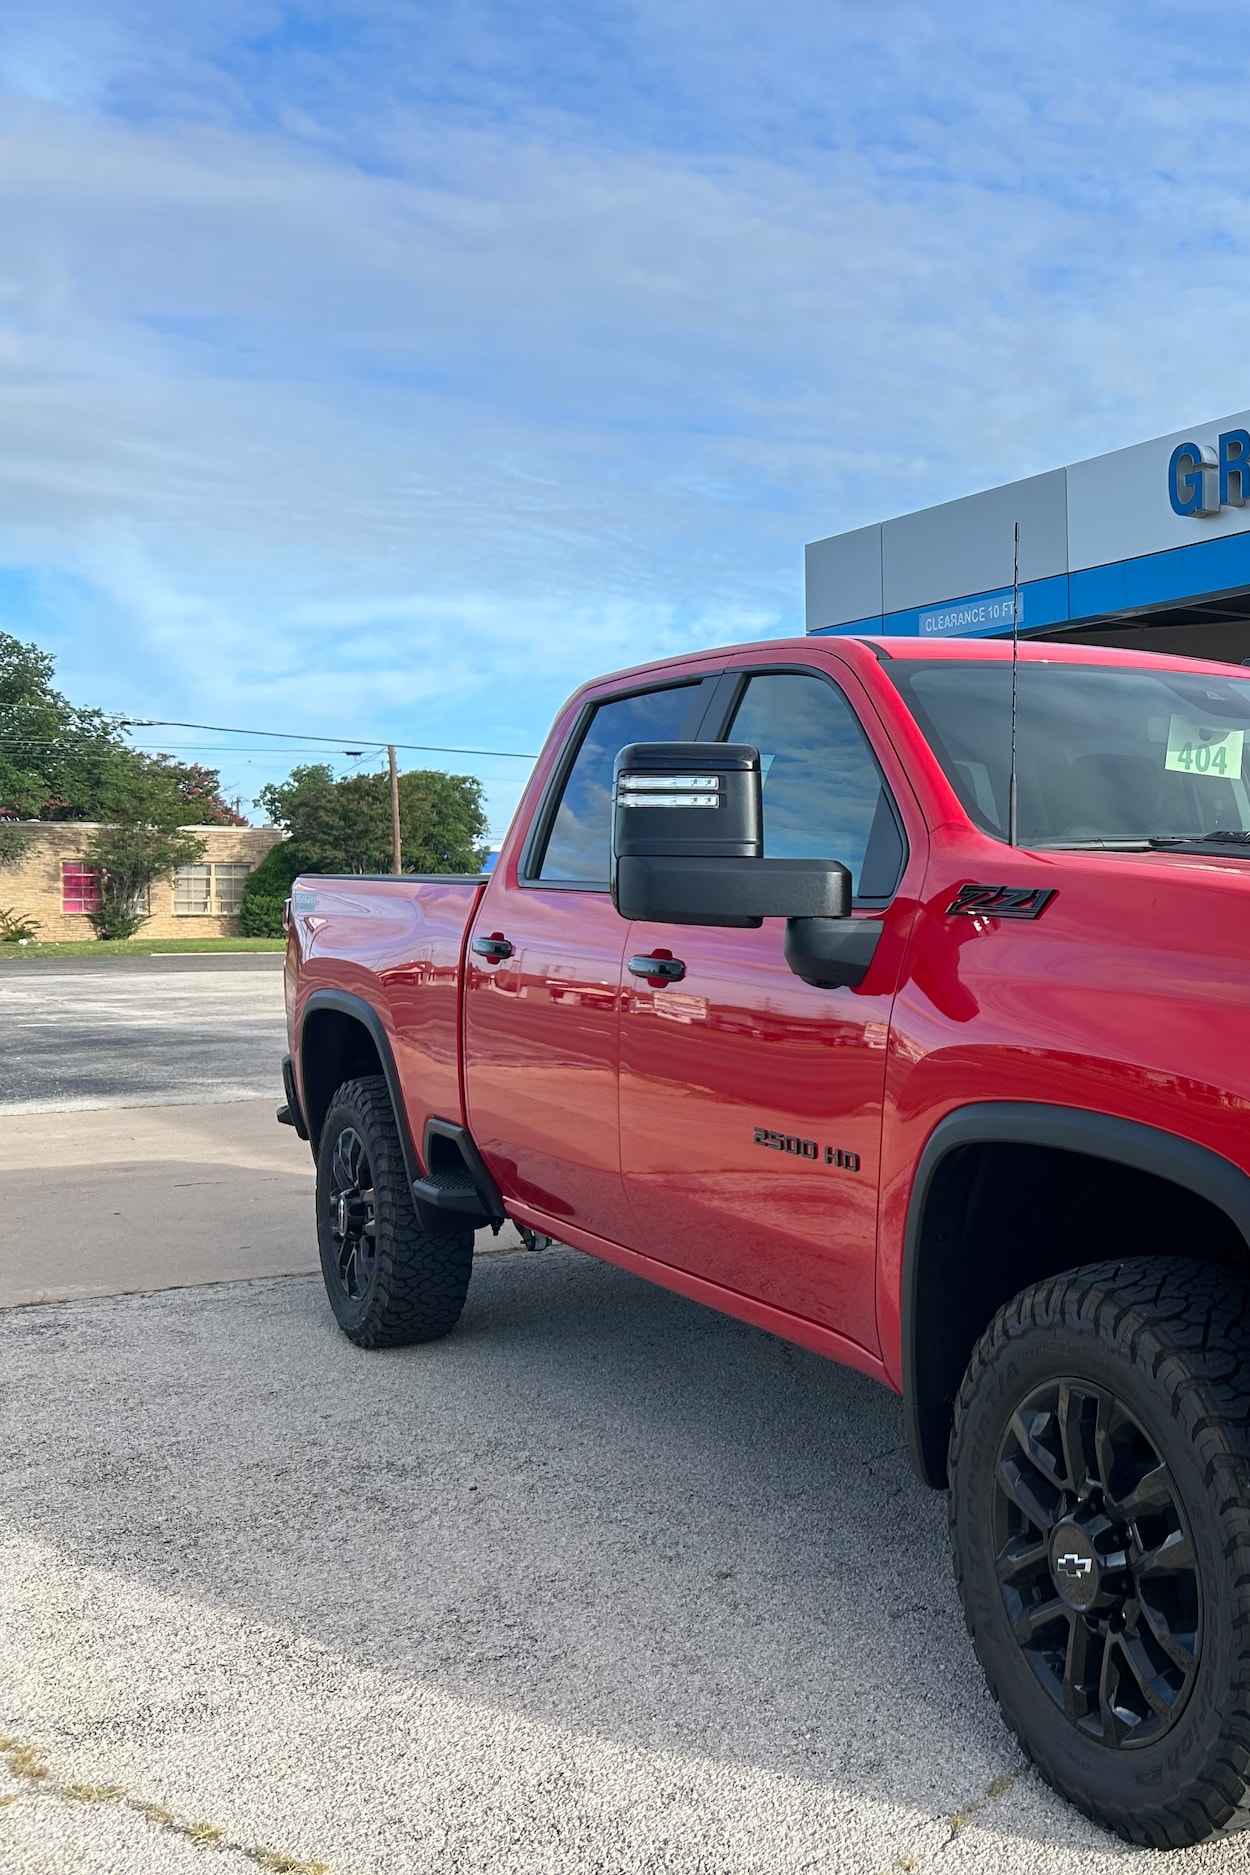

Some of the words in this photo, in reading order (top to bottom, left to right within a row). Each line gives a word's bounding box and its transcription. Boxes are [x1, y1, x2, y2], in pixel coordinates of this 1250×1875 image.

[925, 607, 985, 632] CLEARANCE
[988, 605, 1000, 619] 10
[1002, 601, 1015, 617] FT
[1177, 741, 1228, 775] 404
[944, 883, 1060, 920] Z71
[753, 1126, 819, 1160] 2500
[824, 1145, 861, 1172] HD
